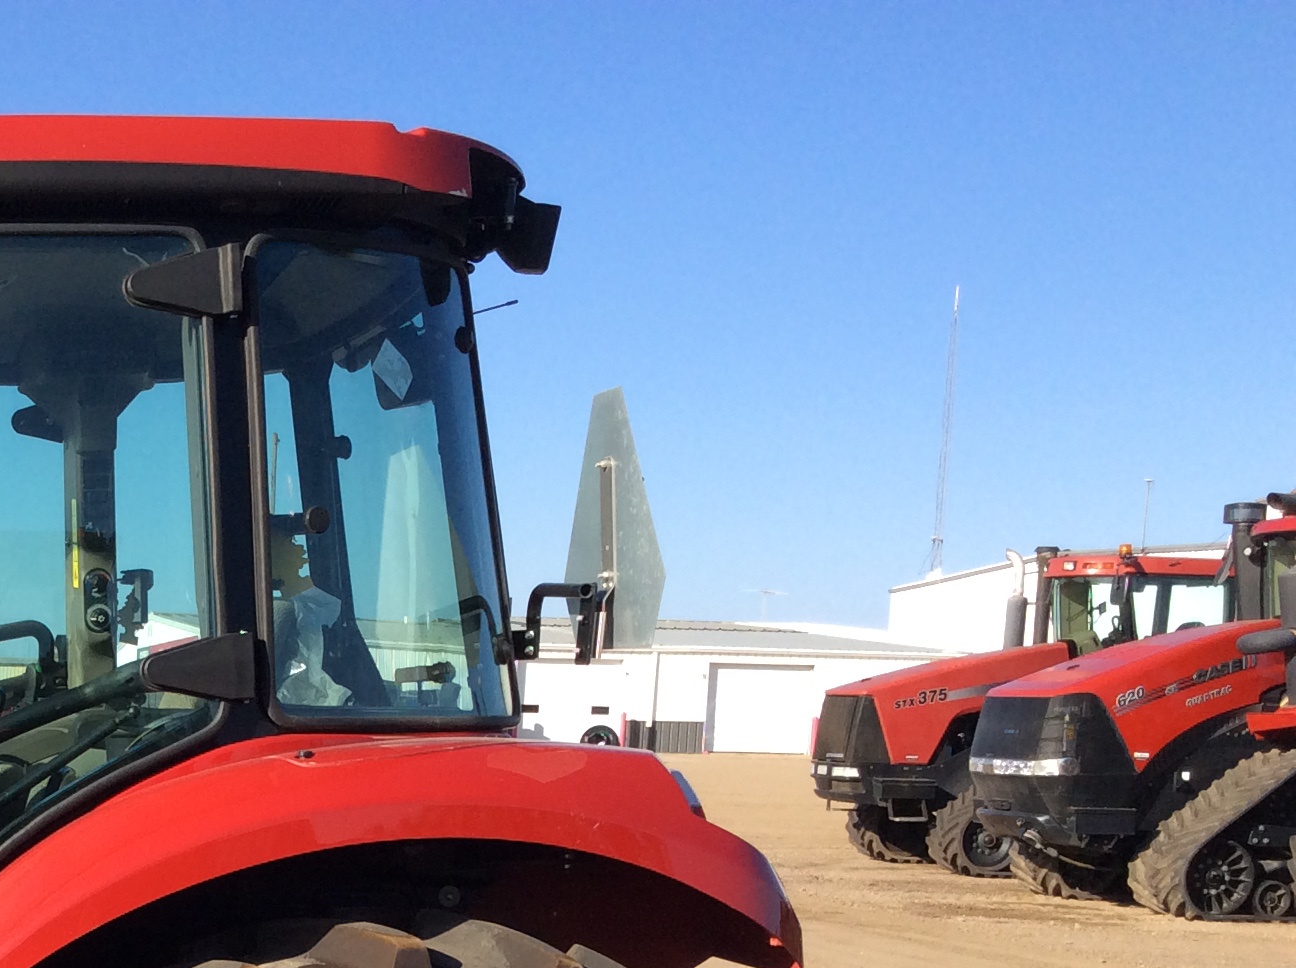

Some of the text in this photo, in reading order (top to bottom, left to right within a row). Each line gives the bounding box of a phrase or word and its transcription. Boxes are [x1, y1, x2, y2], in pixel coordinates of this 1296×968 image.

[894, 688, 948, 709] STX 375
[1115, 685, 1146, 708] 620
